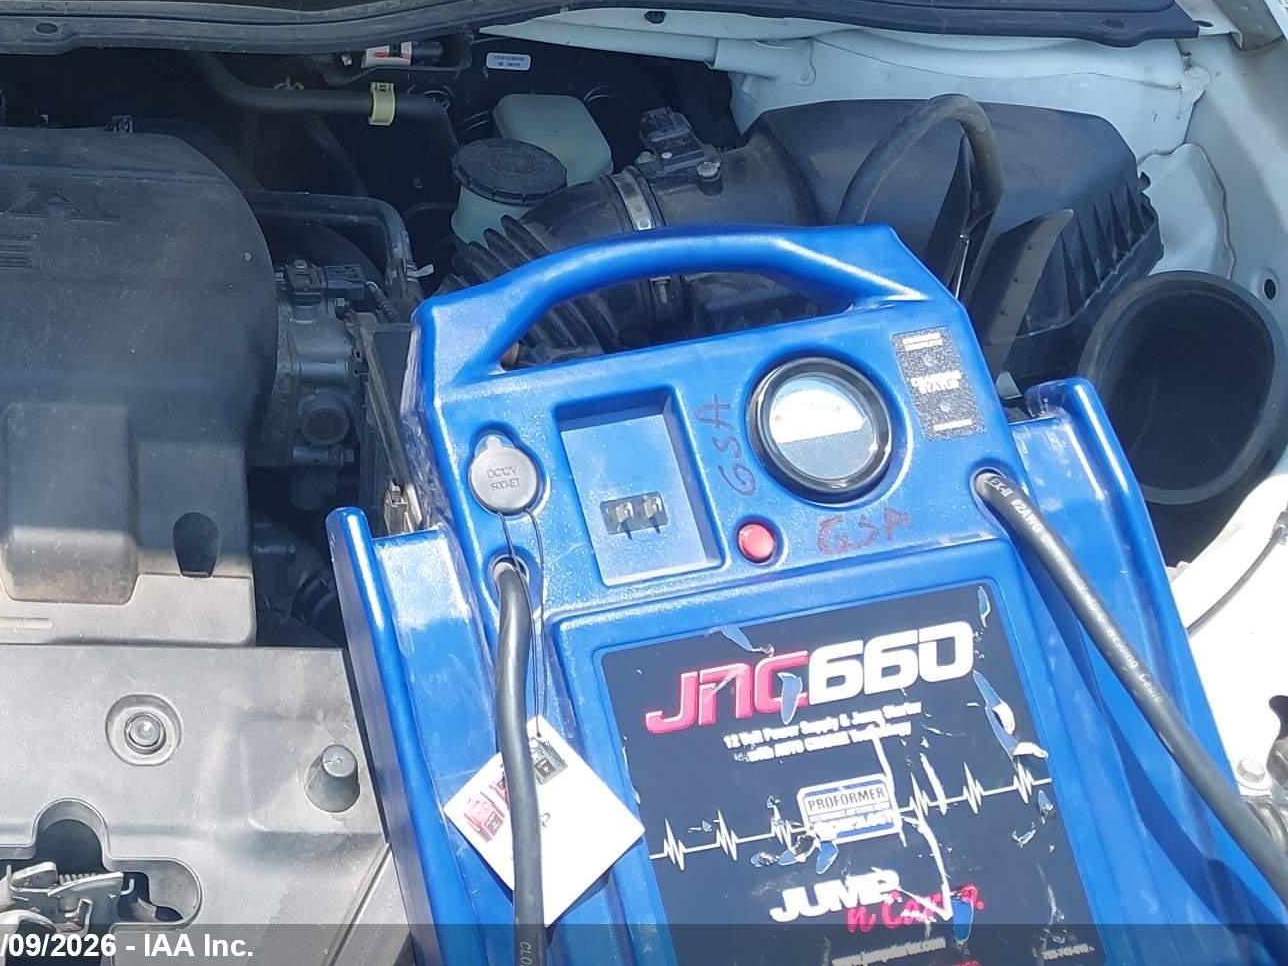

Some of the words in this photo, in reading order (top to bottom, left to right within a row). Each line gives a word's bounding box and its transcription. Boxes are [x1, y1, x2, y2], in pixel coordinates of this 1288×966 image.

[645, 620, 975, 734] JNC660
[807, 786, 886, 812] PROFORMER
[769, 868, 900, 923] JUMP
